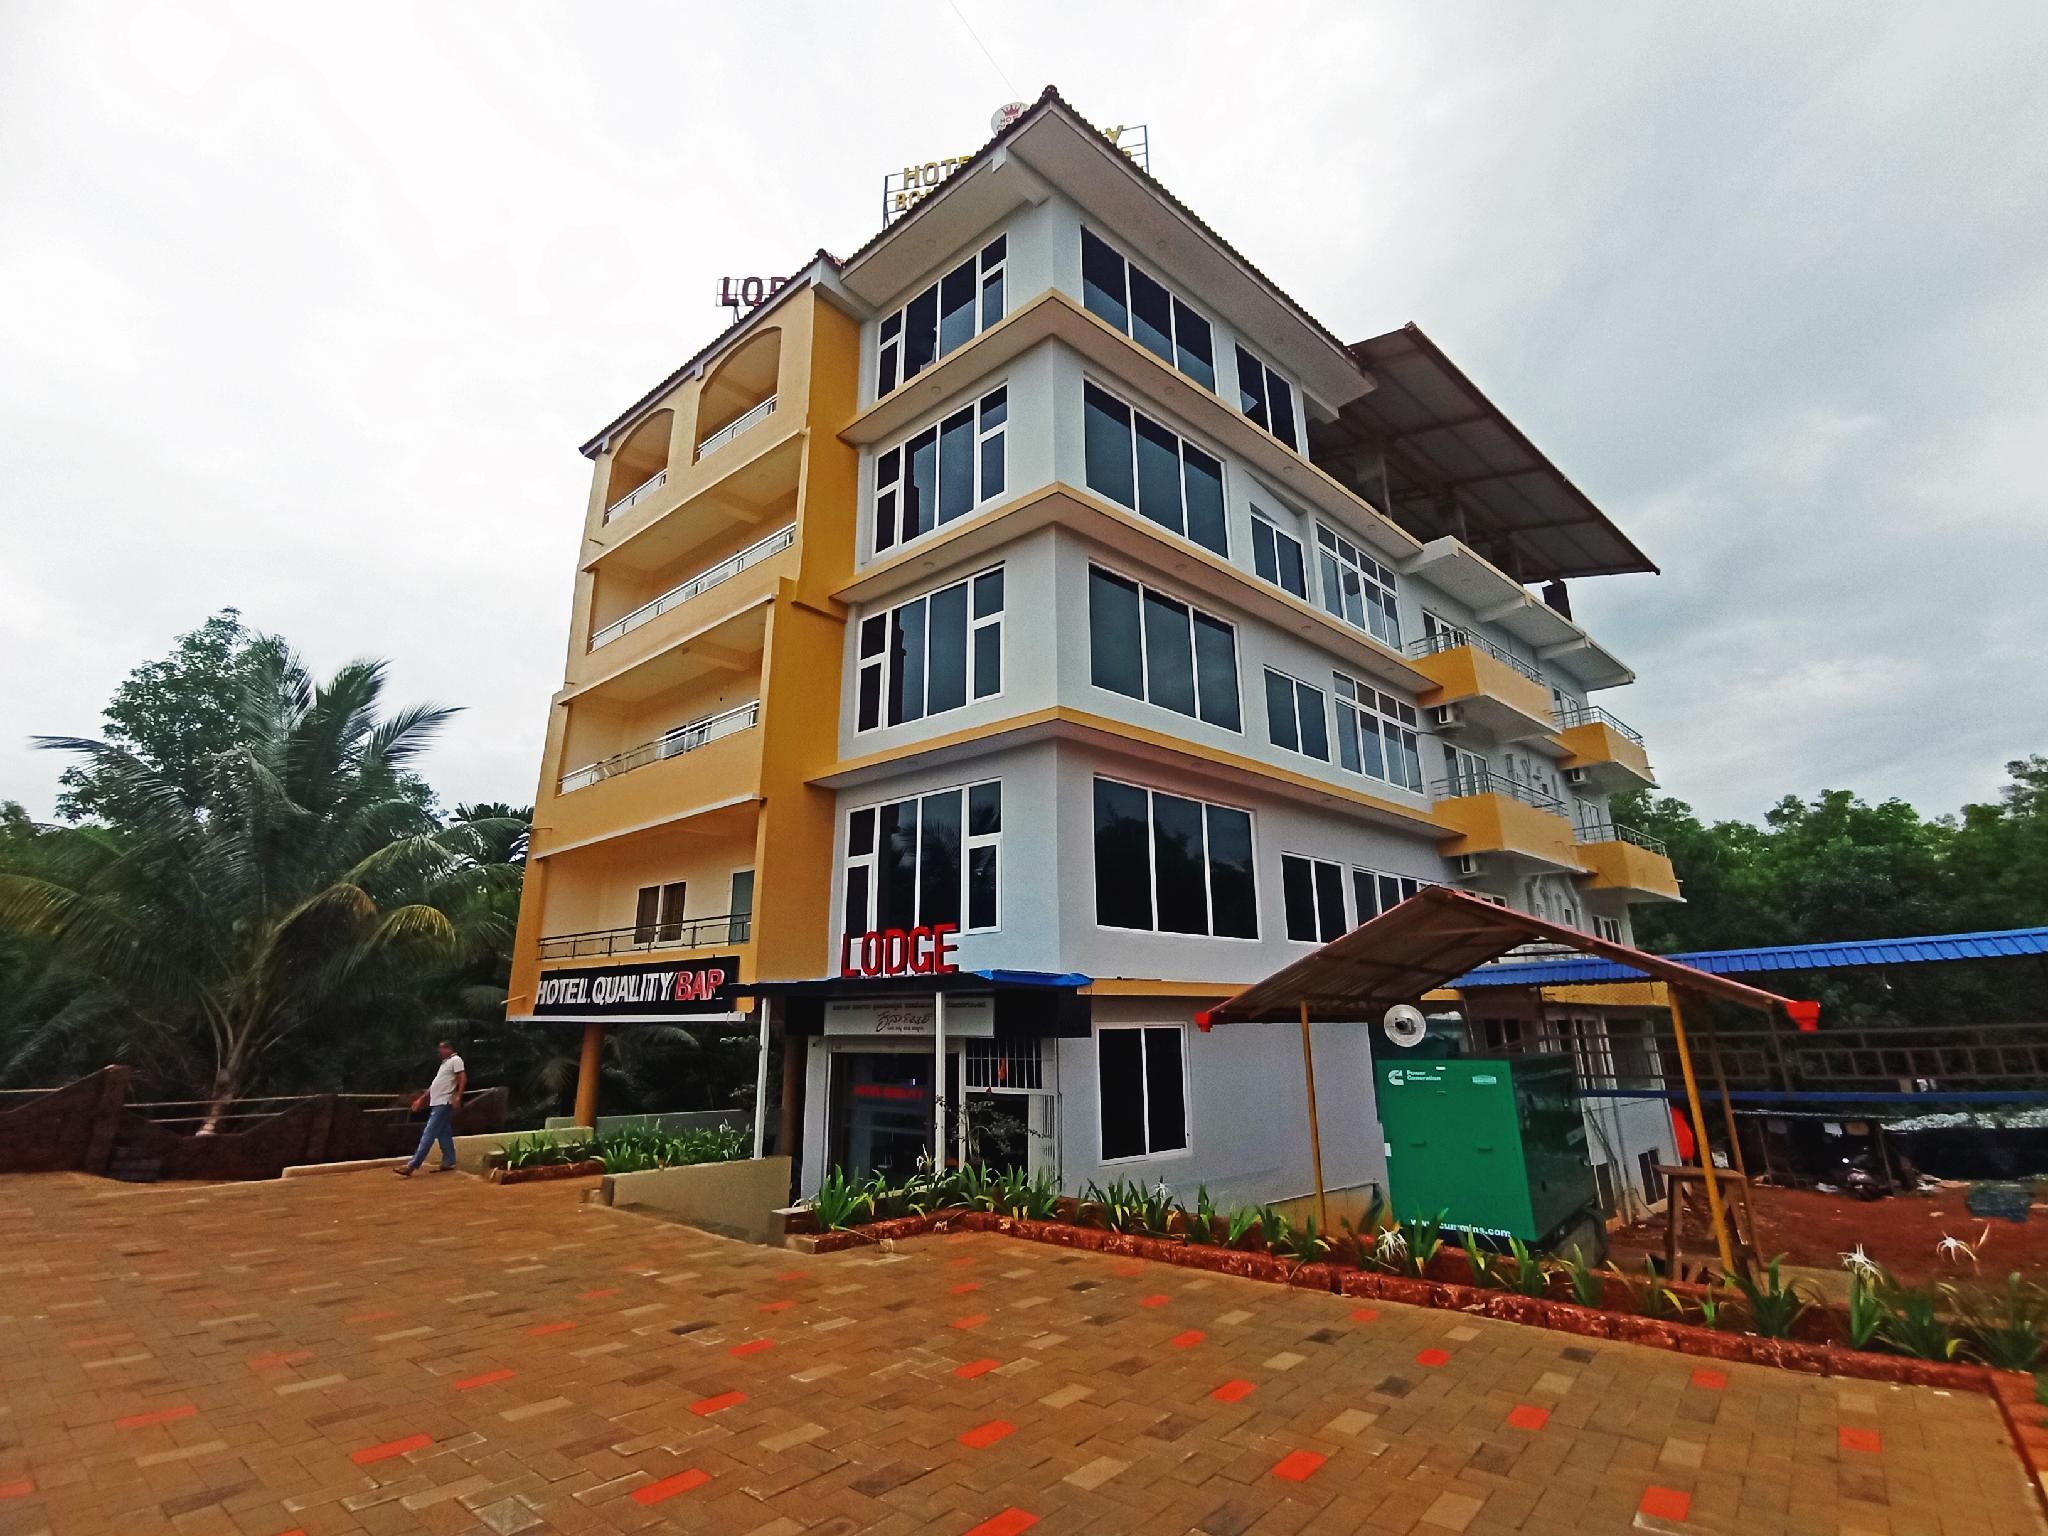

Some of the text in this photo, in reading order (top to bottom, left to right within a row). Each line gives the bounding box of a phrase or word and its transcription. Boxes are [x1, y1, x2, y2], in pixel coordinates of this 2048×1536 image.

[841, 924, 959, 977] LODGE
[535, 968, 725, 1006] HOTEL QUALITY BAR
